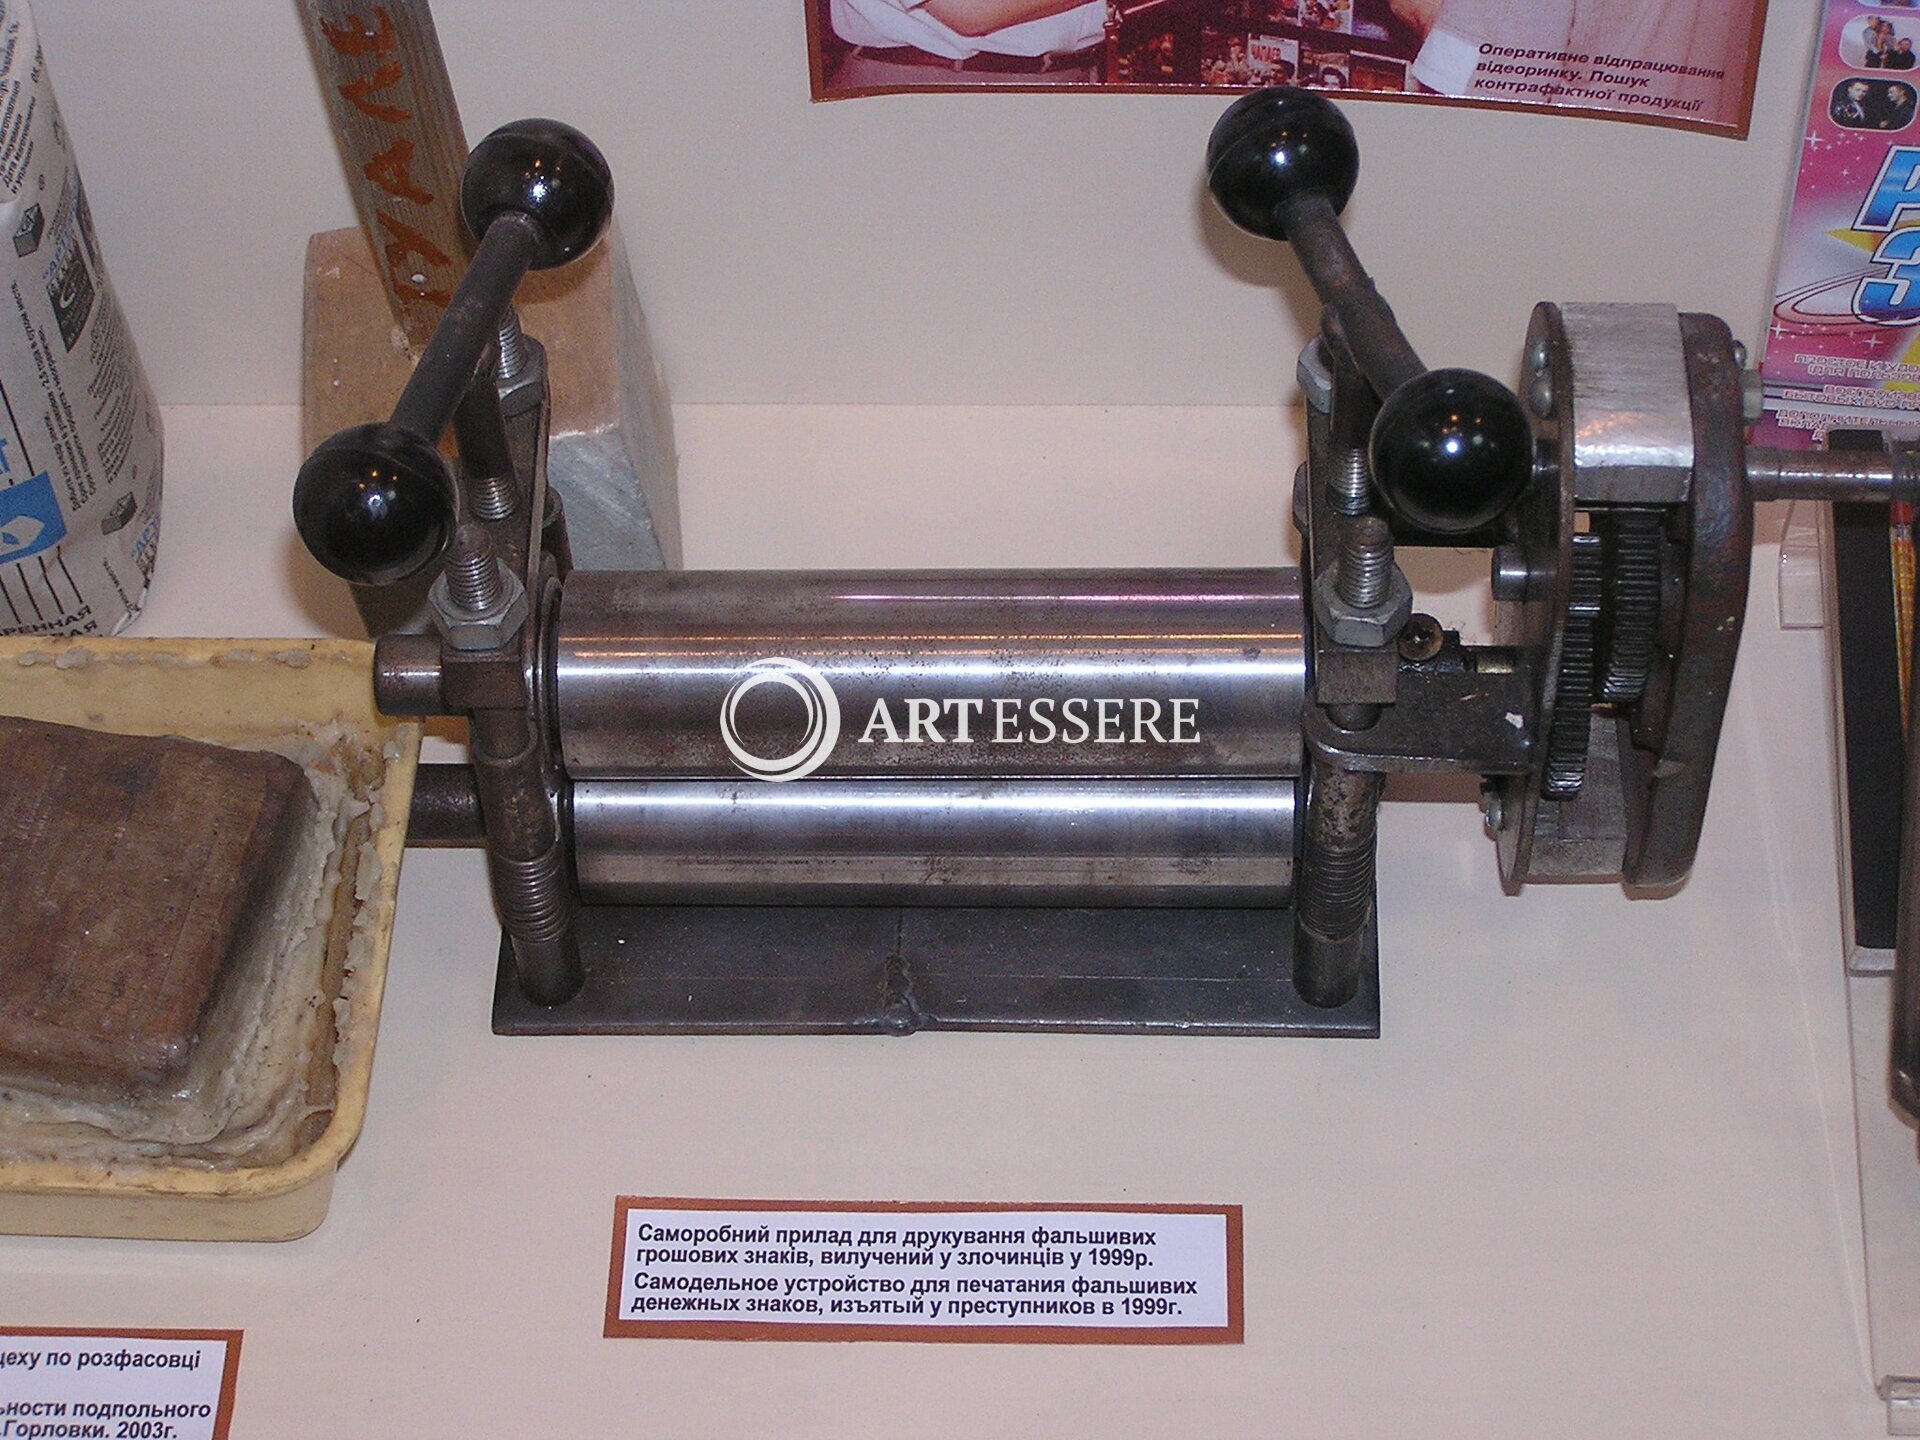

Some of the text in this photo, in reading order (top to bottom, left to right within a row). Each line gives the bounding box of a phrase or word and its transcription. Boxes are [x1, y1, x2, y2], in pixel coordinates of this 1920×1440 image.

[1479, 43, 1725, 80] Оперативне відпрацювання
[1476, 60, 1650, 88] відеоринку. Пошук
[1475, 78, 1704, 112] контрафактної продукції
[638, 1223, 1157, 1248] Саморобний прилад для друкування фальшивих
[636, 1246, 1153, 1270] грошових знаків, вилучений у злочинців у 1999р.
[634, 1272, 1198, 1297] Самодельное устройство для печатания фальшивих
[631, 1295, 1182, 1318] денежных знаков, изъятый у преступников в 1999г.
[46, 1353, 71, 1366] по
[77, 1349, 201, 1371] розфасовці
[72, 1403, 211, 1419] подпольного
[116, 1421, 178, 1439] 2003г.
